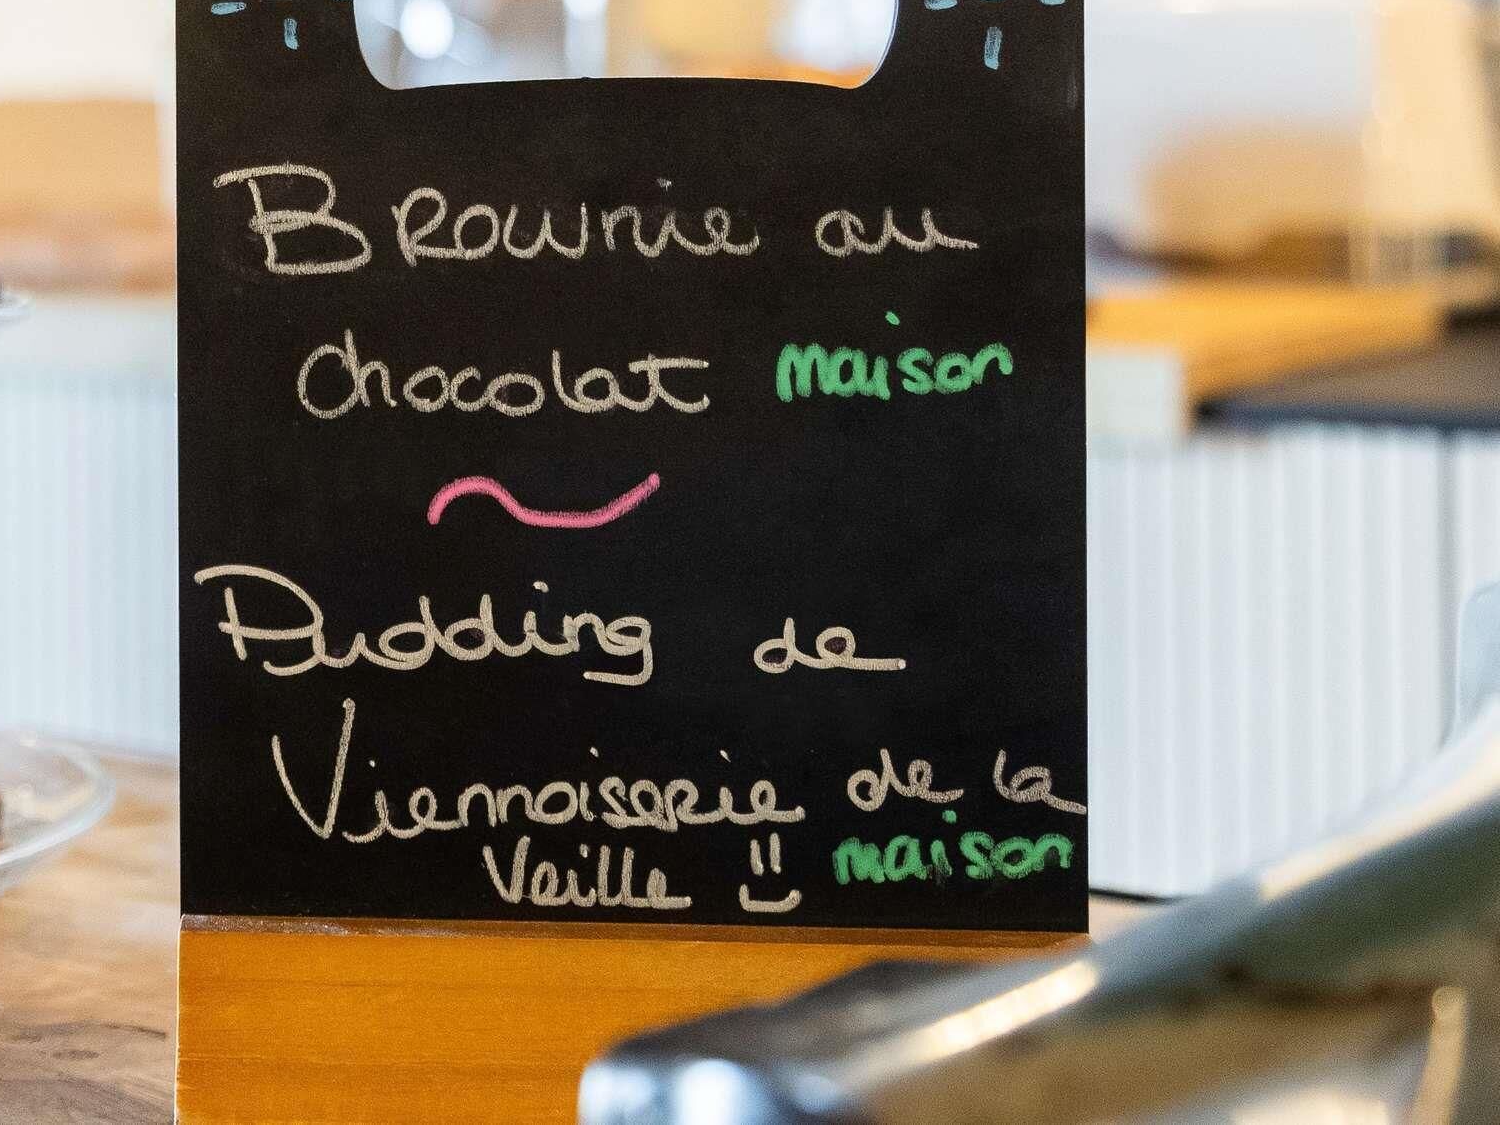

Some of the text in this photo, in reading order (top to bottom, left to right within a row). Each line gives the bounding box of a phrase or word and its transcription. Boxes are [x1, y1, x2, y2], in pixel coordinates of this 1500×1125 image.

[814, 207, 980, 258] au
[297, 312, 1013, 419] chocolat maison
[194, 564, 907, 686] Pudding de
[846, 748, 965, 812] de
[993, 749, 1085, 815] la
[482, 811, 1073, 909] Veille maison
